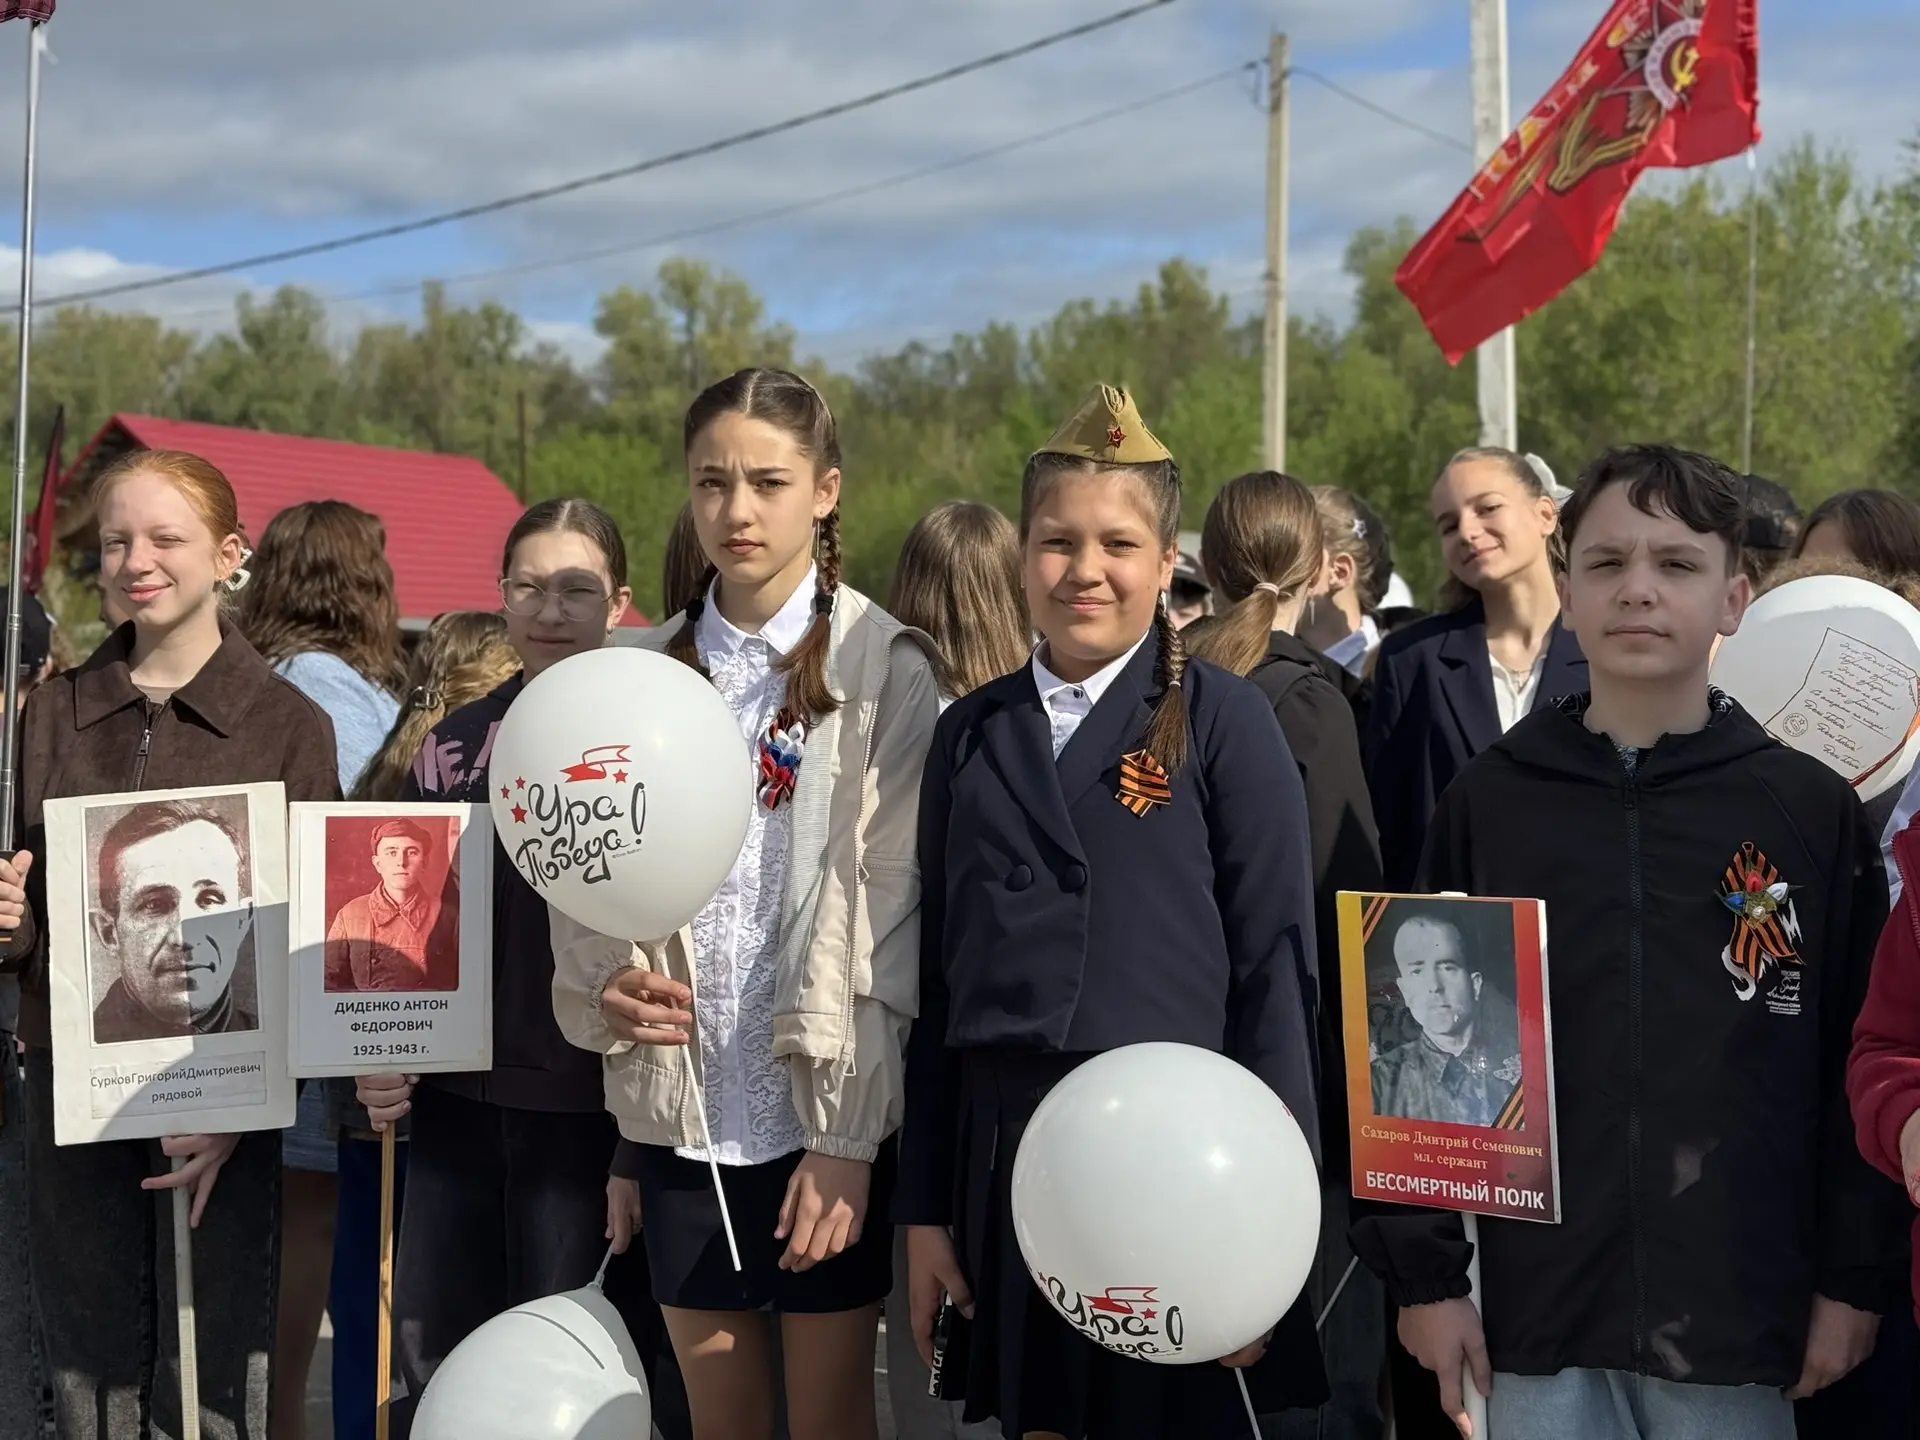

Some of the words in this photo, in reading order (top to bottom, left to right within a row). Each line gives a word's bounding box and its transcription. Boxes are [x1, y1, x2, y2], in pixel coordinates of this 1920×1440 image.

[334, 1000, 400, 1015] ДИДЕНКО
[403, 999, 448, 1011] АНТОН
[350, 1019, 433, 1034] ФЕДОРОВИЧ
[353, 1043, 418, 1056] 1925-1943
[421, 1045, 430, 1054] г.
[151, 1087, 202, 1104] рядовой
[1361, 1125, 1410, 1143] Сахаров
[1413, 1131, 1469, 1149] Дмитрий
[1472, 1137, 1543, 1157] Семенович
[1413, 1152, 1434, 1164] мл.
[1436, 1154, 1489, 1170] сержант
[1366, 1170, 1489, 1203] БЕССМЕРТНЫЙ
[1495, 1186, 1545, 1210] ПОЛК
